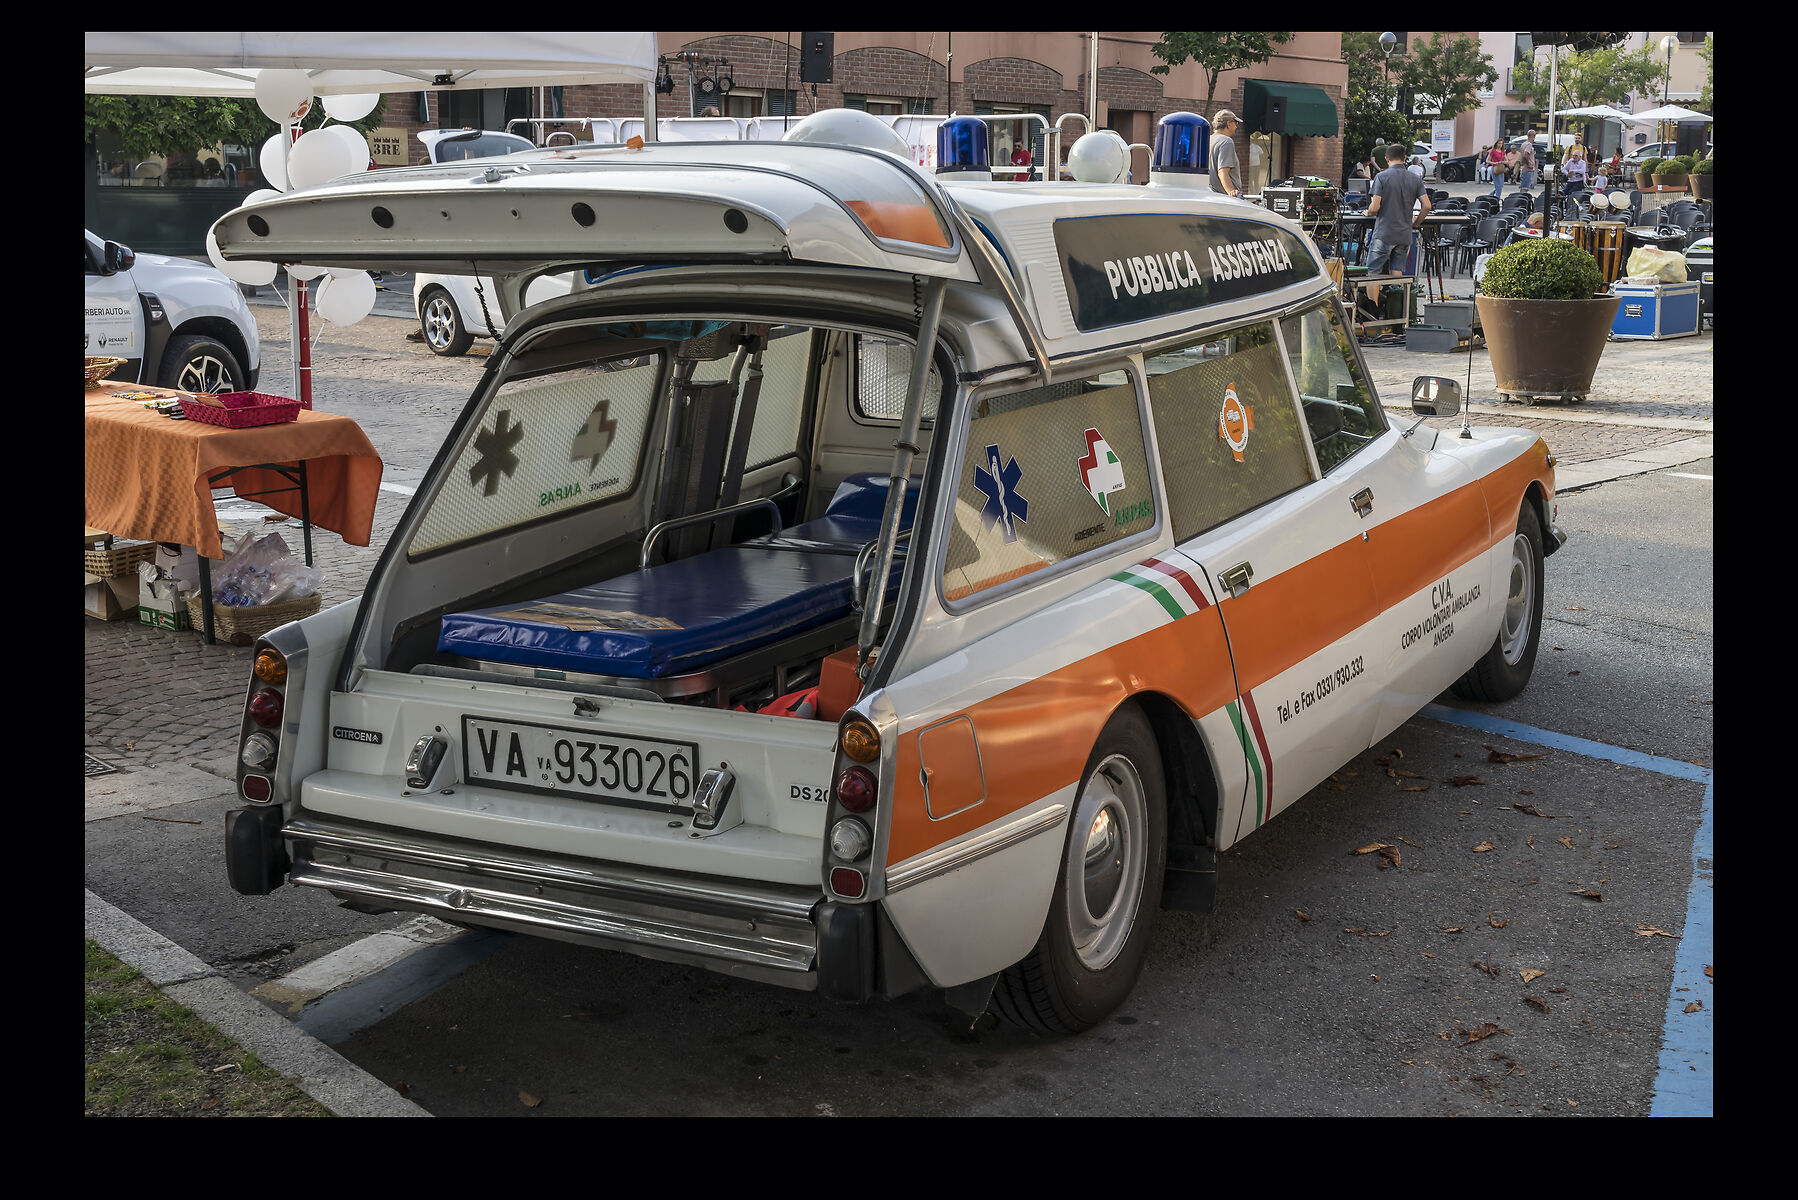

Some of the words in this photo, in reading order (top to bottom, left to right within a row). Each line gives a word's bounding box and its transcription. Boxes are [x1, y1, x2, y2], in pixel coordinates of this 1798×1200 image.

[373, 144, 401, 156] 3RE
[1103, 250, 1202, 300] PUBBLICA
[1207, 238, 1293, 283] ASSISTENZA
[105, 308, 123, 316] AUTO
[1431, 578, 1454, 610] C.V.A.
[1401, 623, 1422, 650] CORPO
[1422, 603, 1451, 636] VOLONTARI
[1451, 583, 1481, 616] AMBULANZA
[1433, 621, 1455, 648] ANGERA
[1277, 700, 1293, 725] Tel.
[1294, 700, 1301, 715] e
[1301, 691, 1316, 711] Fax
[1316, 655, 1365, 700] 0331/930.332
[477, 727, 527, 778] VA
[554, 738, 690, 799] 933026
[790, 785, 811, 801] DS
